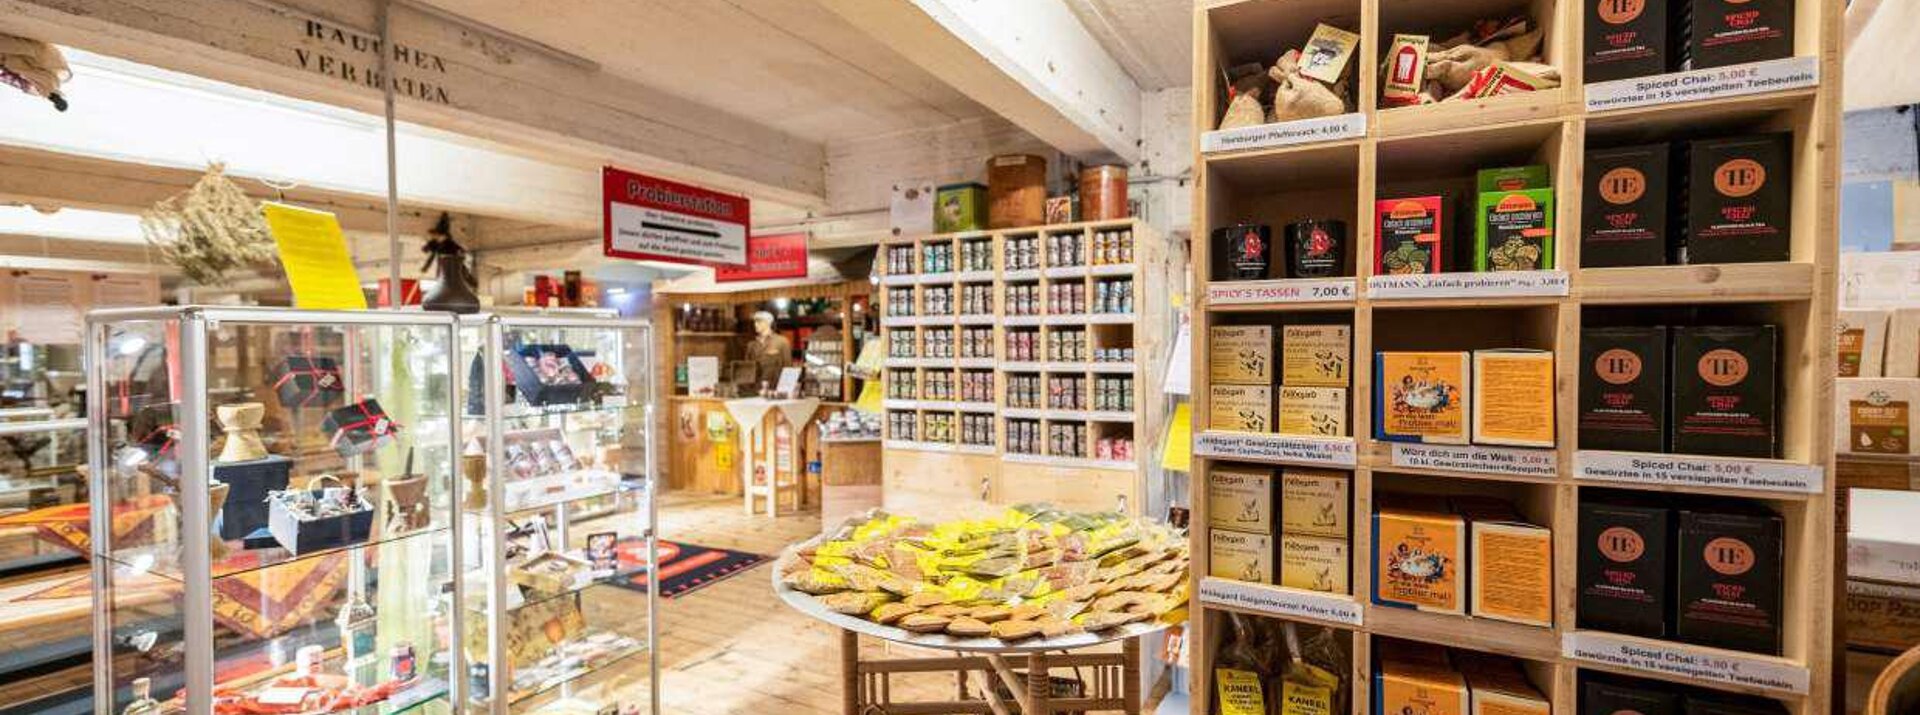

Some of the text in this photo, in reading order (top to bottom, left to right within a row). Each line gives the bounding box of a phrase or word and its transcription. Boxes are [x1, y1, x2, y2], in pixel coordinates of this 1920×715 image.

[1636, 77, 1678, 92] Spiced
[1682, 74, 1714, 86] Chai:
[1749, 67, 1759, 77] €
[1588, 94, 1645, 106] Gewürztee
[1659, 90, 1672, 99] 15
[1674, 81, 1743, 96] versiegelten
[1607, 176, 1637, 195] TE
[1722, 167, 1757, 188] TE
[1255, 286, 1301, 299] TASSEN
[1312, 286, 1338, 298] 7,00
[1342, 286, 1351, 297] €
[1603, 357, 1634, 375] TE
[1706, 357, 1741, 376] TE
[1428, 449, 1450, 459] dich
[1452, 452, 1469, 460] um
[1471, 451, 1488, 461] die
[1631, 458, 1675, 472] Spiced
[1677, 461, 1712, 473] Chai:
[1714, 464, 1742, 475] 5,00
[1585, 466, 1640, 480] Gewürztee
[1655, 471, 1668, 480] 15
[1670, 473, 1738, 487] versiegelten
[1603, 534, 1636, 554] TE
[1713, 546, 1746, 566] TE
[1574, 649, 1629, 665] Gewürztee
[1643, 659, 1656, 669] 15
[1620, 644, 1664, 661] Spiced
[1665, 650, 1700, 664] Chai:
[1223, 683, 1261, 695] KANEEL
[1287, 695, 1327, 710] KANEEL
